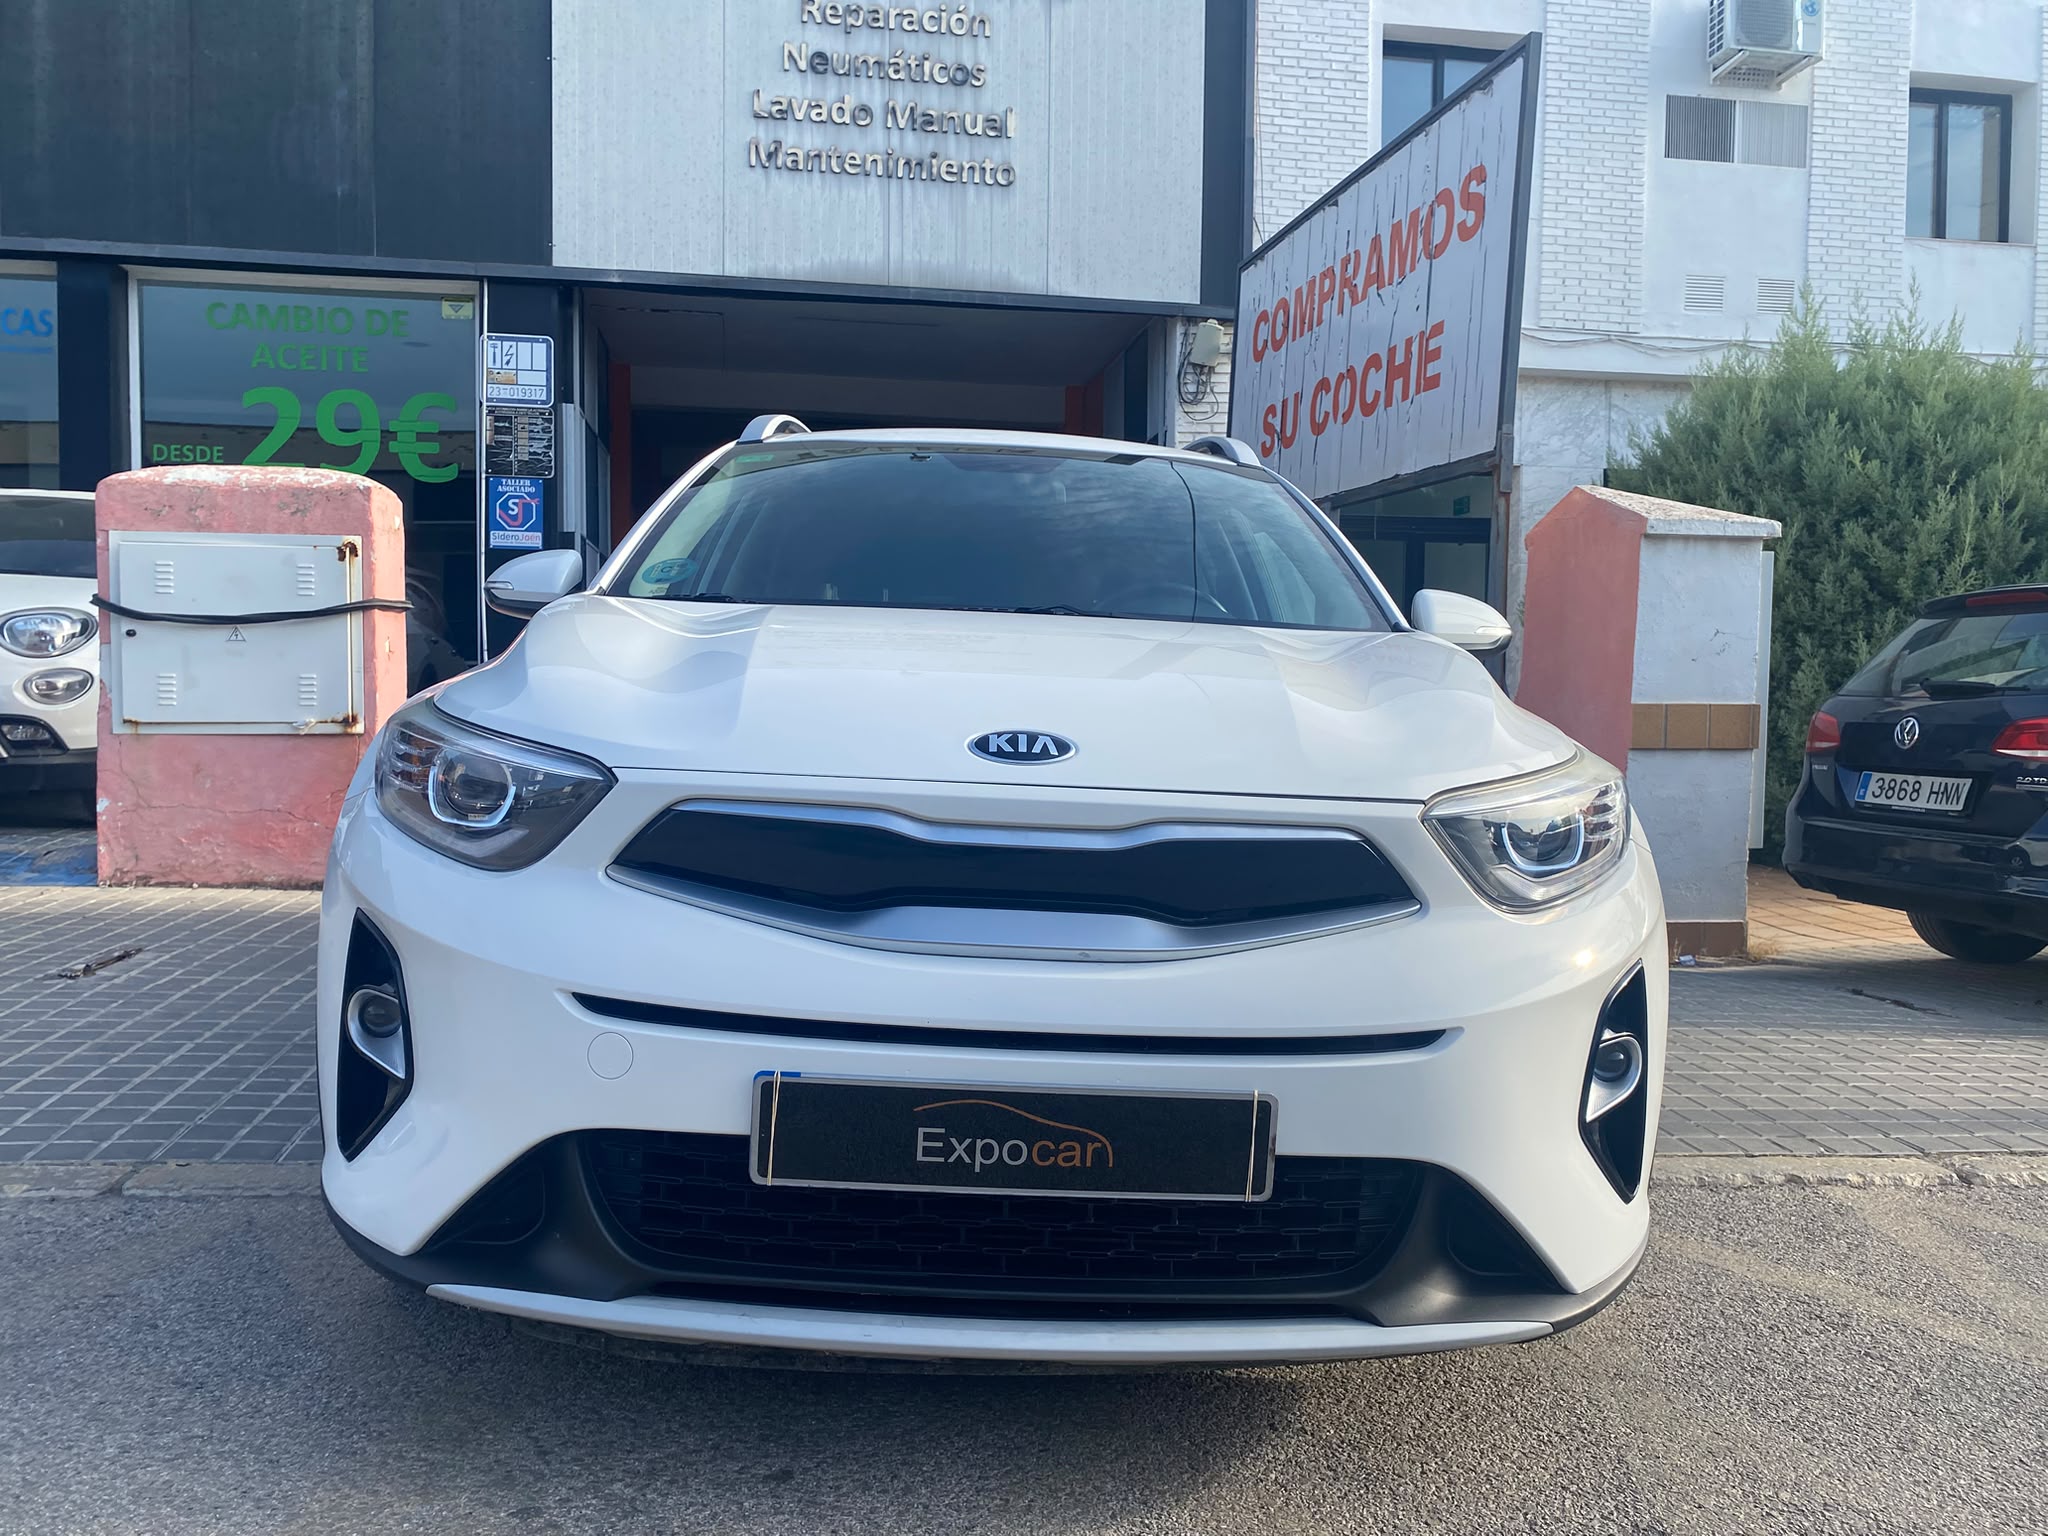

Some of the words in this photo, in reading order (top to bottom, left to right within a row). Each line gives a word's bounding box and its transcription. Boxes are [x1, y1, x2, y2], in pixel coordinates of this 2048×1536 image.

[801, 0, 991, 38] Reparación
[783, 41, 987, 88] Neumáticos
[753, 88, 874, 127] Lavado
[886, 99, 1015, 139] Manual
[748, 137, 1016, 187] Mantenimiento
[1252, 163, 1487, 363] COMPRAMOS
[205, 301, 355, 335] CAMBIO
[365, 308, 409, 338] DE
[251, 343, 369, 373] ACEITE
[1261, 391, 1302, 459] SU
[1310, 319, 1446, 437] COCHE
[152, 444, 225, 464] DESDE
[242, 386, 459, 483] 29€
[496, 485, 536, 493] ASOCIADO
[988, 733, 1059, 755] KIA
[1872, 777, 1922, 802] 3868
[1926, 781, 1967, 806] HNN
[916, 1127, 1102, 1173] Expocar
